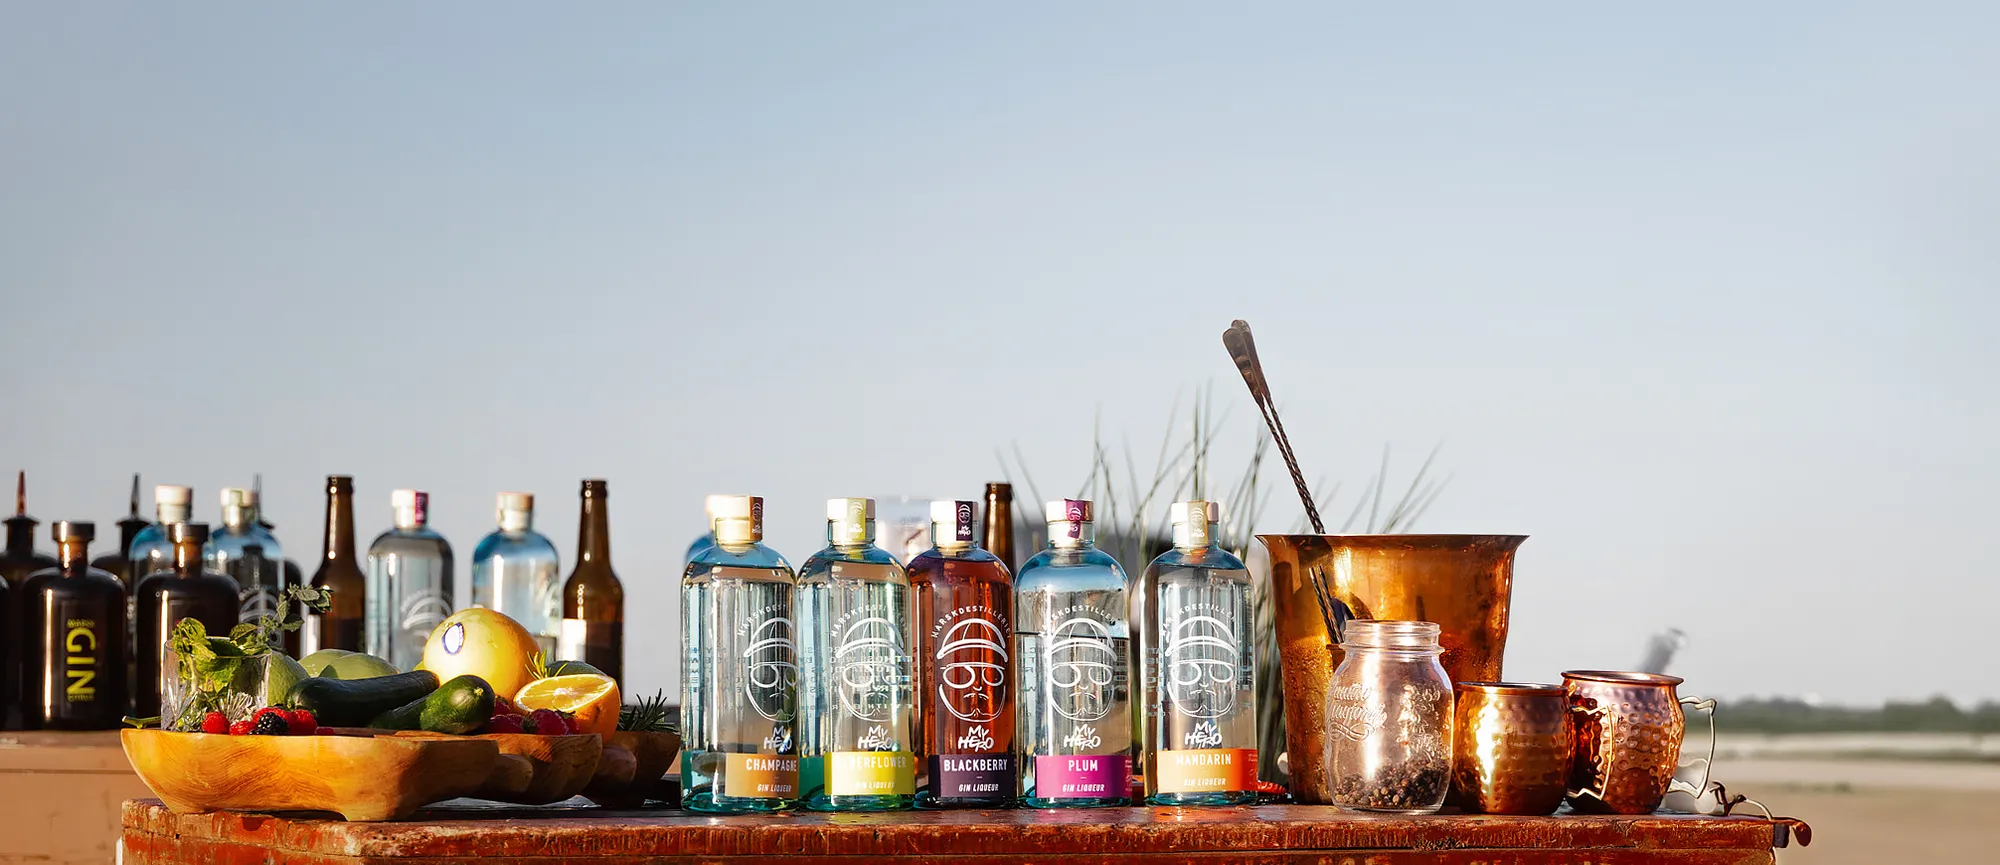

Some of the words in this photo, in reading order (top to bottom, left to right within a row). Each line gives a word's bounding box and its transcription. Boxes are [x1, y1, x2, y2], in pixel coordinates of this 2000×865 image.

[66, 627, 96, 695] GIN
[857, 736, 894, 752] HERO
[957, 736, 995, 753] HERO
[1063, 734, 1101, 751] HERO
[1184, 731, 1223, 748] HERO
[745, 758, 797, 772] CHAMPAGNE
[943, 758, 1008, 772] BLACKBERRY
[1068, 759, 1098, 772] PLUM
[1175, 753, 1232, 766] MANDARIN
[757, 783, 769, 792] GIN
[770, 784, 792, 792] LIQUEUR
[958, 783, 971, 792] GIN
[973, 783, 999, 792] LIQUEUR
[1062, 784, 1075, 792] GIN
[1076, 784, 1105, 792] LIQUEUR
[1197, 777, 1227, 786] LIQUEUR
